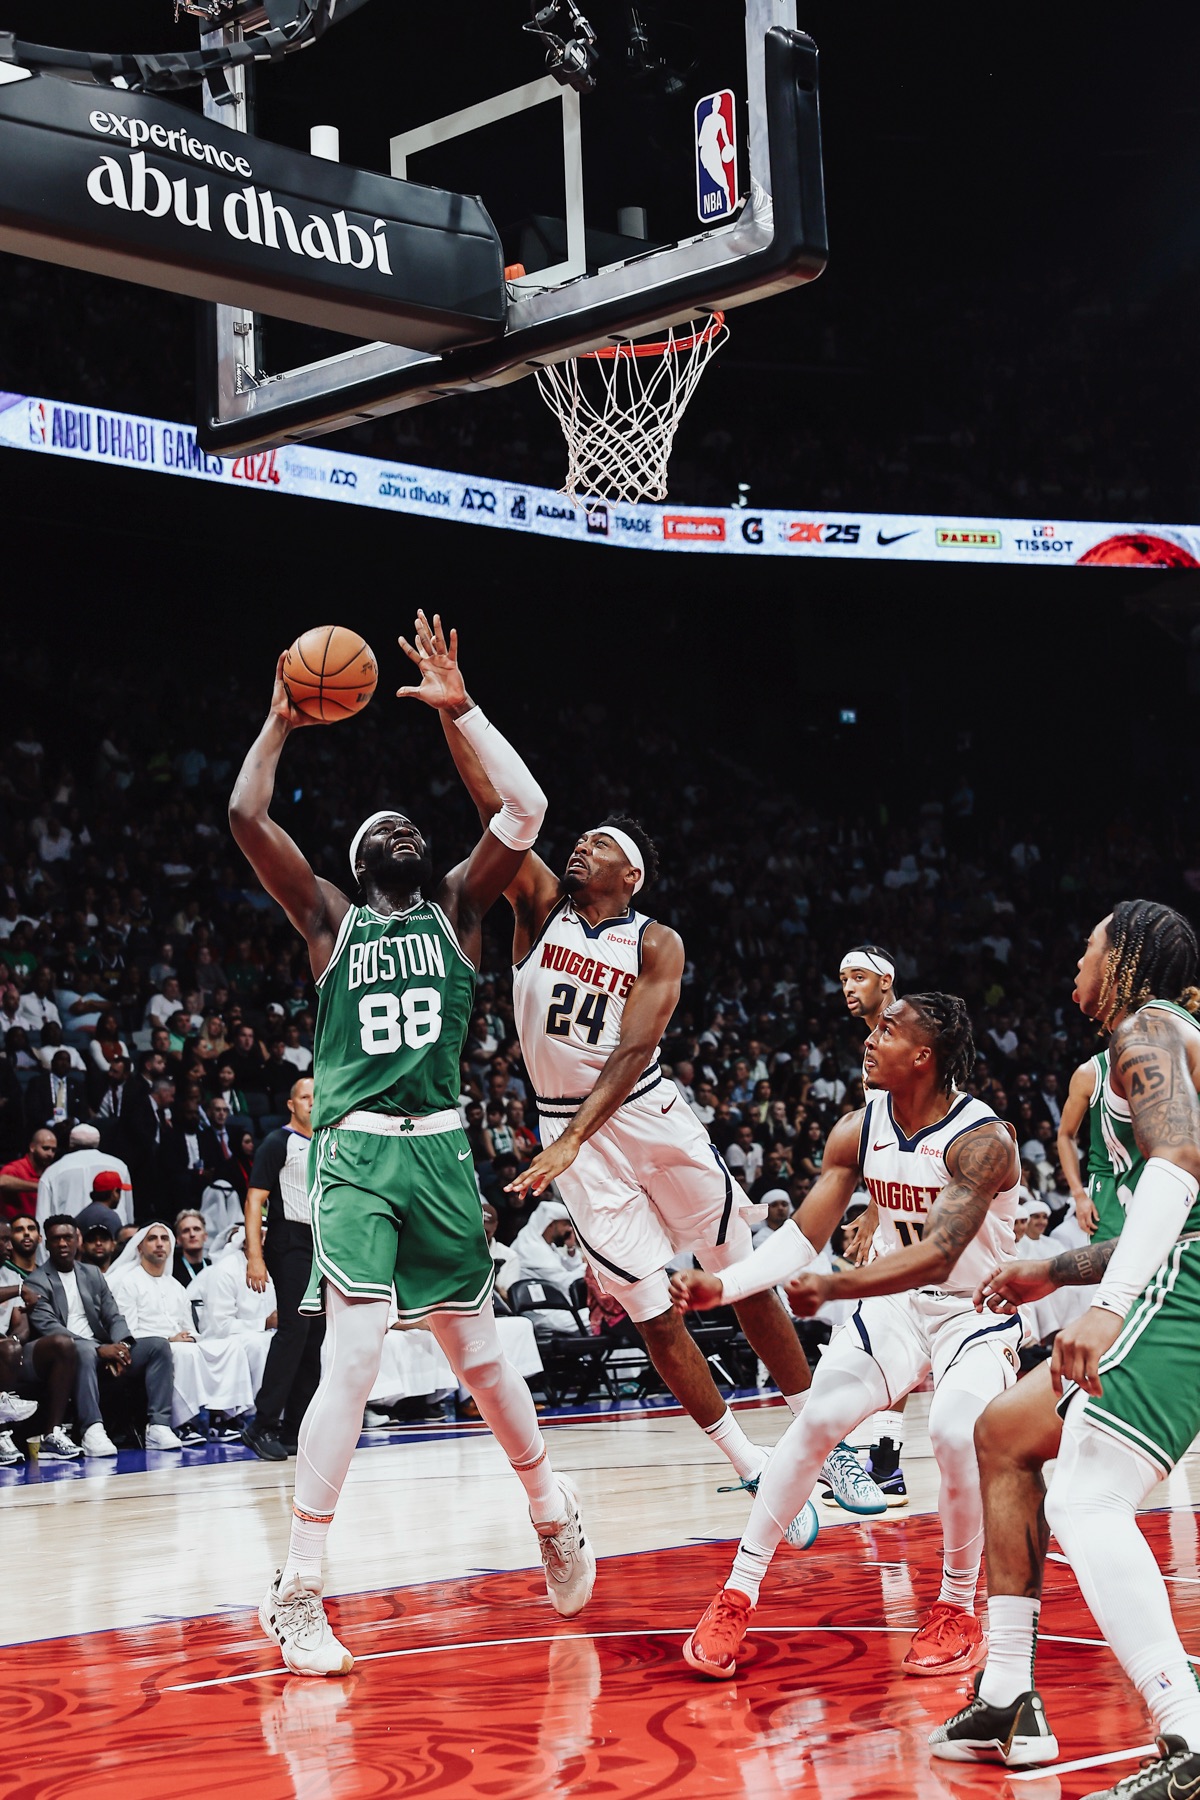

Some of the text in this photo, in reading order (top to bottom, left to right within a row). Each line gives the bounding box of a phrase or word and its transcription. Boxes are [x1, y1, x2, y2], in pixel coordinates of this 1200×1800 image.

[89, 109, 252, 178] experience
[87, 151, 393, 275] abu dhabi
[703, 190, 723, 214] NBA
[52, 407, 91, 452] ABU
[97, 415, 155, 463] DHABI
[379, 482, 406, 499] abu
[742, 517, 763, 545] G
[788, 523, 860, 543] 2K25
[941, 533, 997, 544] PANINI
[1015, 539, 1073, 552] TISSOT
[607, 933, 637, 946] ibotta
[349, 934, 446, 991] BOSTON
[540, 943, 638, 998] NUGGETS
[359, 987, 443, 1056] 88
[545, 983, 609, 1045] 24
[1130, 1065, 1165, 1098] 45
[864, 1177, 946, 1213] NUGGET
